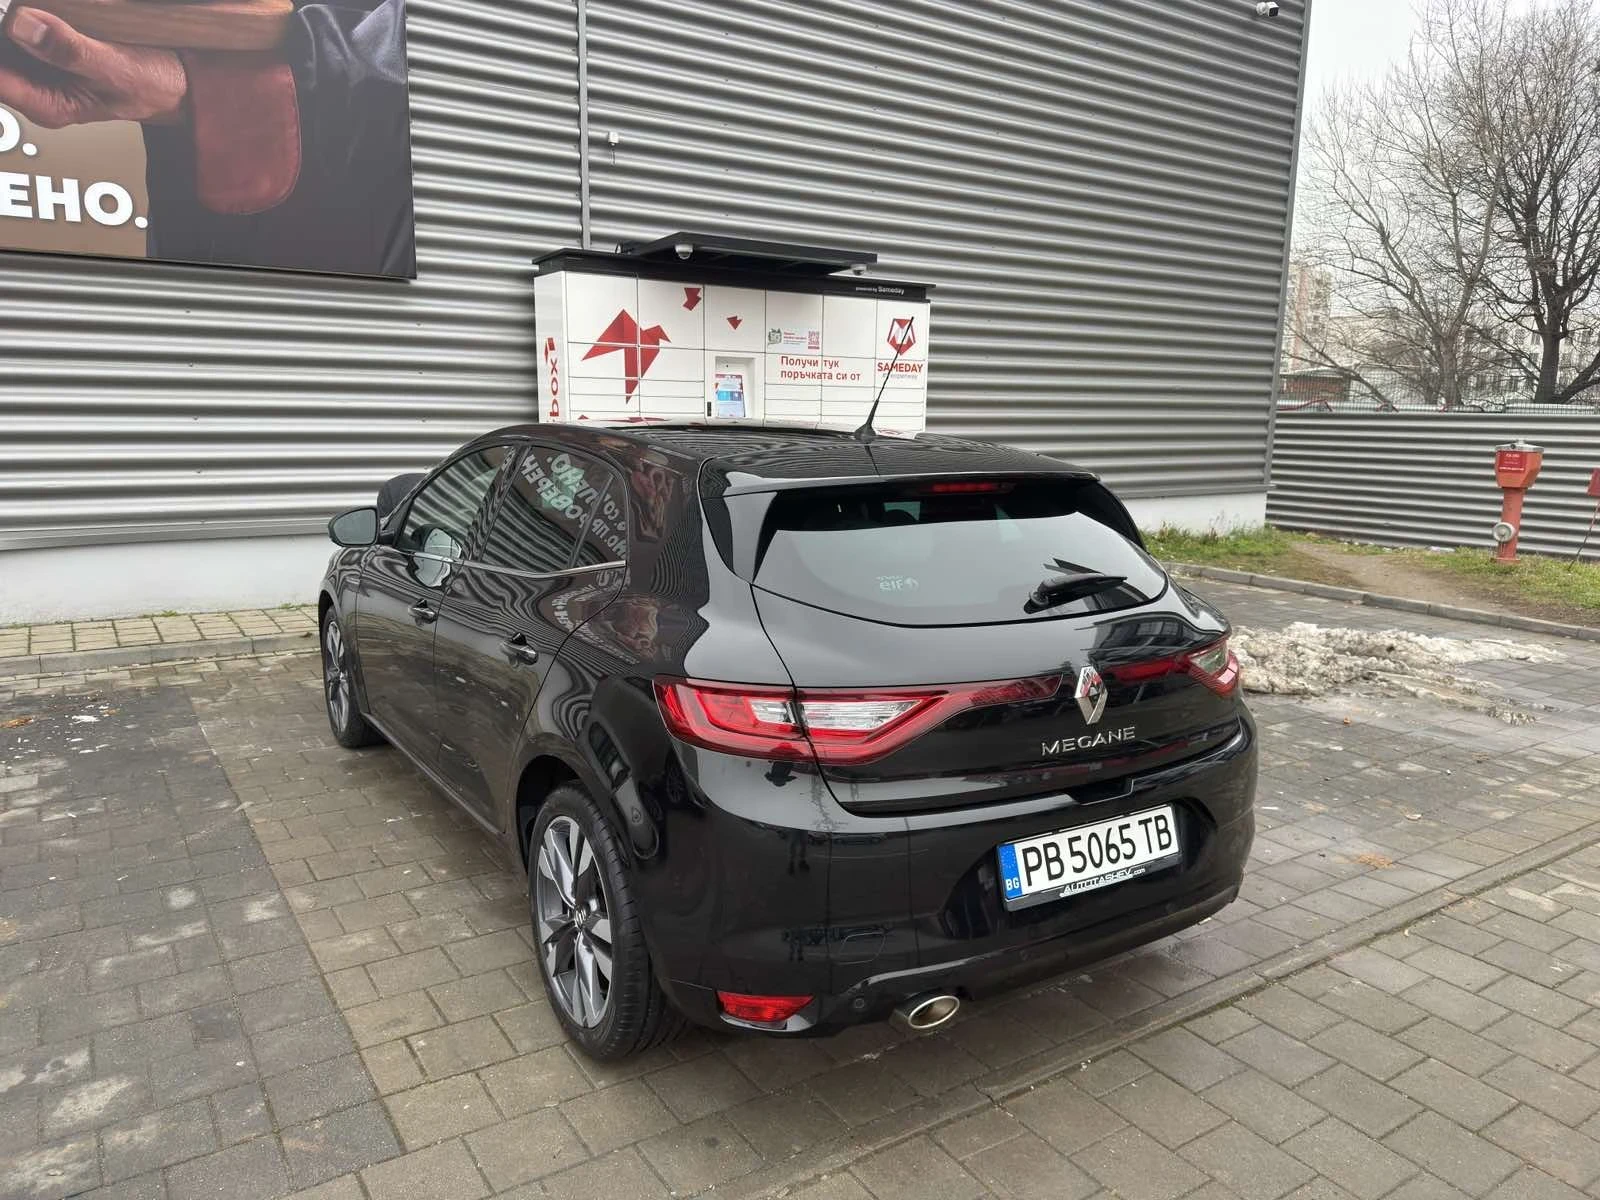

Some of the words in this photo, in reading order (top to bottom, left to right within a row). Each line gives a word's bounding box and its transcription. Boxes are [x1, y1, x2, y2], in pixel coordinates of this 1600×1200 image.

[878, 286, 905, 296] Sameday
[781, 355, 819, 369] Получи
[823, 360, 840, 370] тук
[877, 361, 923, 373] SAMEDAY
[780, 370, 833, 380] поръчката
[836, 373, 848, 381] си
[850, 373, 861, 381] от
[1041, 726, 1136, 757] MEGANE
[1022, 841, 1065, 887] PB
[1067, 823, 1136, 874] 5065
[1138, 814, 1172, 854] TB
[1005, 877, 1020, 891] BG
